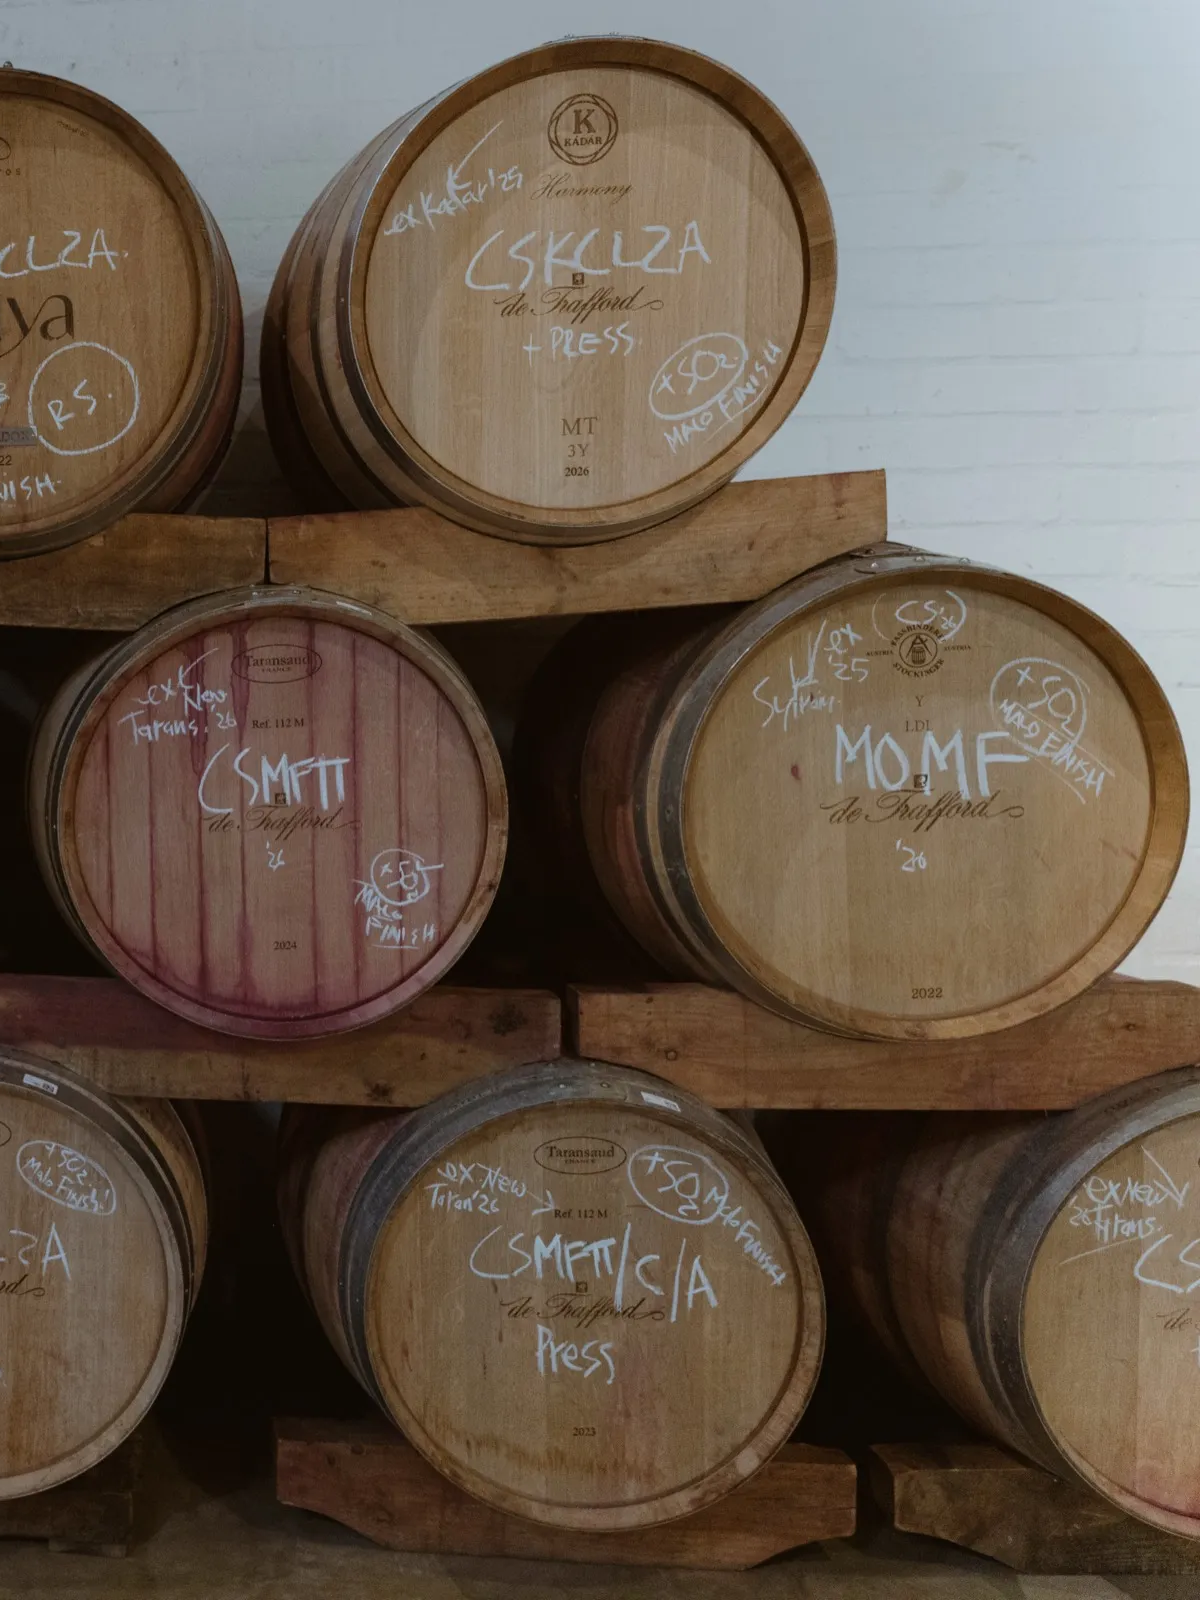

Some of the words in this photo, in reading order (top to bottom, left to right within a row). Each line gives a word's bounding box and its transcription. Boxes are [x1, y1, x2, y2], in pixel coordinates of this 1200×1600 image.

[572, 109, 596, 134] K
[530, 172, 635, 206] Harmony
[493, 292, 530, 319] de
[531, 284, 664, 324] Trafford
[550, 321, 633, 361] PRESS
[561, 416, 598, 437] MT
[567, 443, 590, 458] 3Y
[564, 465, 590, 477] 2026
[892, 658, 945, 679] STOCKINGER
[915, 695, 924, 707] Y
[252, 718, 271, 729] Ref.
[275, 718, 293, 729] 112
[294, 718, 305, 729] M
[905, 720, 934, 733] LDL
[835, 724, 1031, 800] MOMF
[820, 796, 863, 825] de
[863, 788, 1025, 833] Trafford
[202, 812, 235, 835] de
[237, 804, 361, 841] Trafford
[273, 940, 298, 950] 2024
[910, 986, 944, 999] 2022
[547, 1145, 616, 1159] Taransaud
[554, 1208, 573, 1220] Ref.
[577, 1208, 596, 1220] 112
[597, 1208, 609, 1220] M
[498, 1298, 533, 1321] de
[536, 1324, 616, 1386] Press
